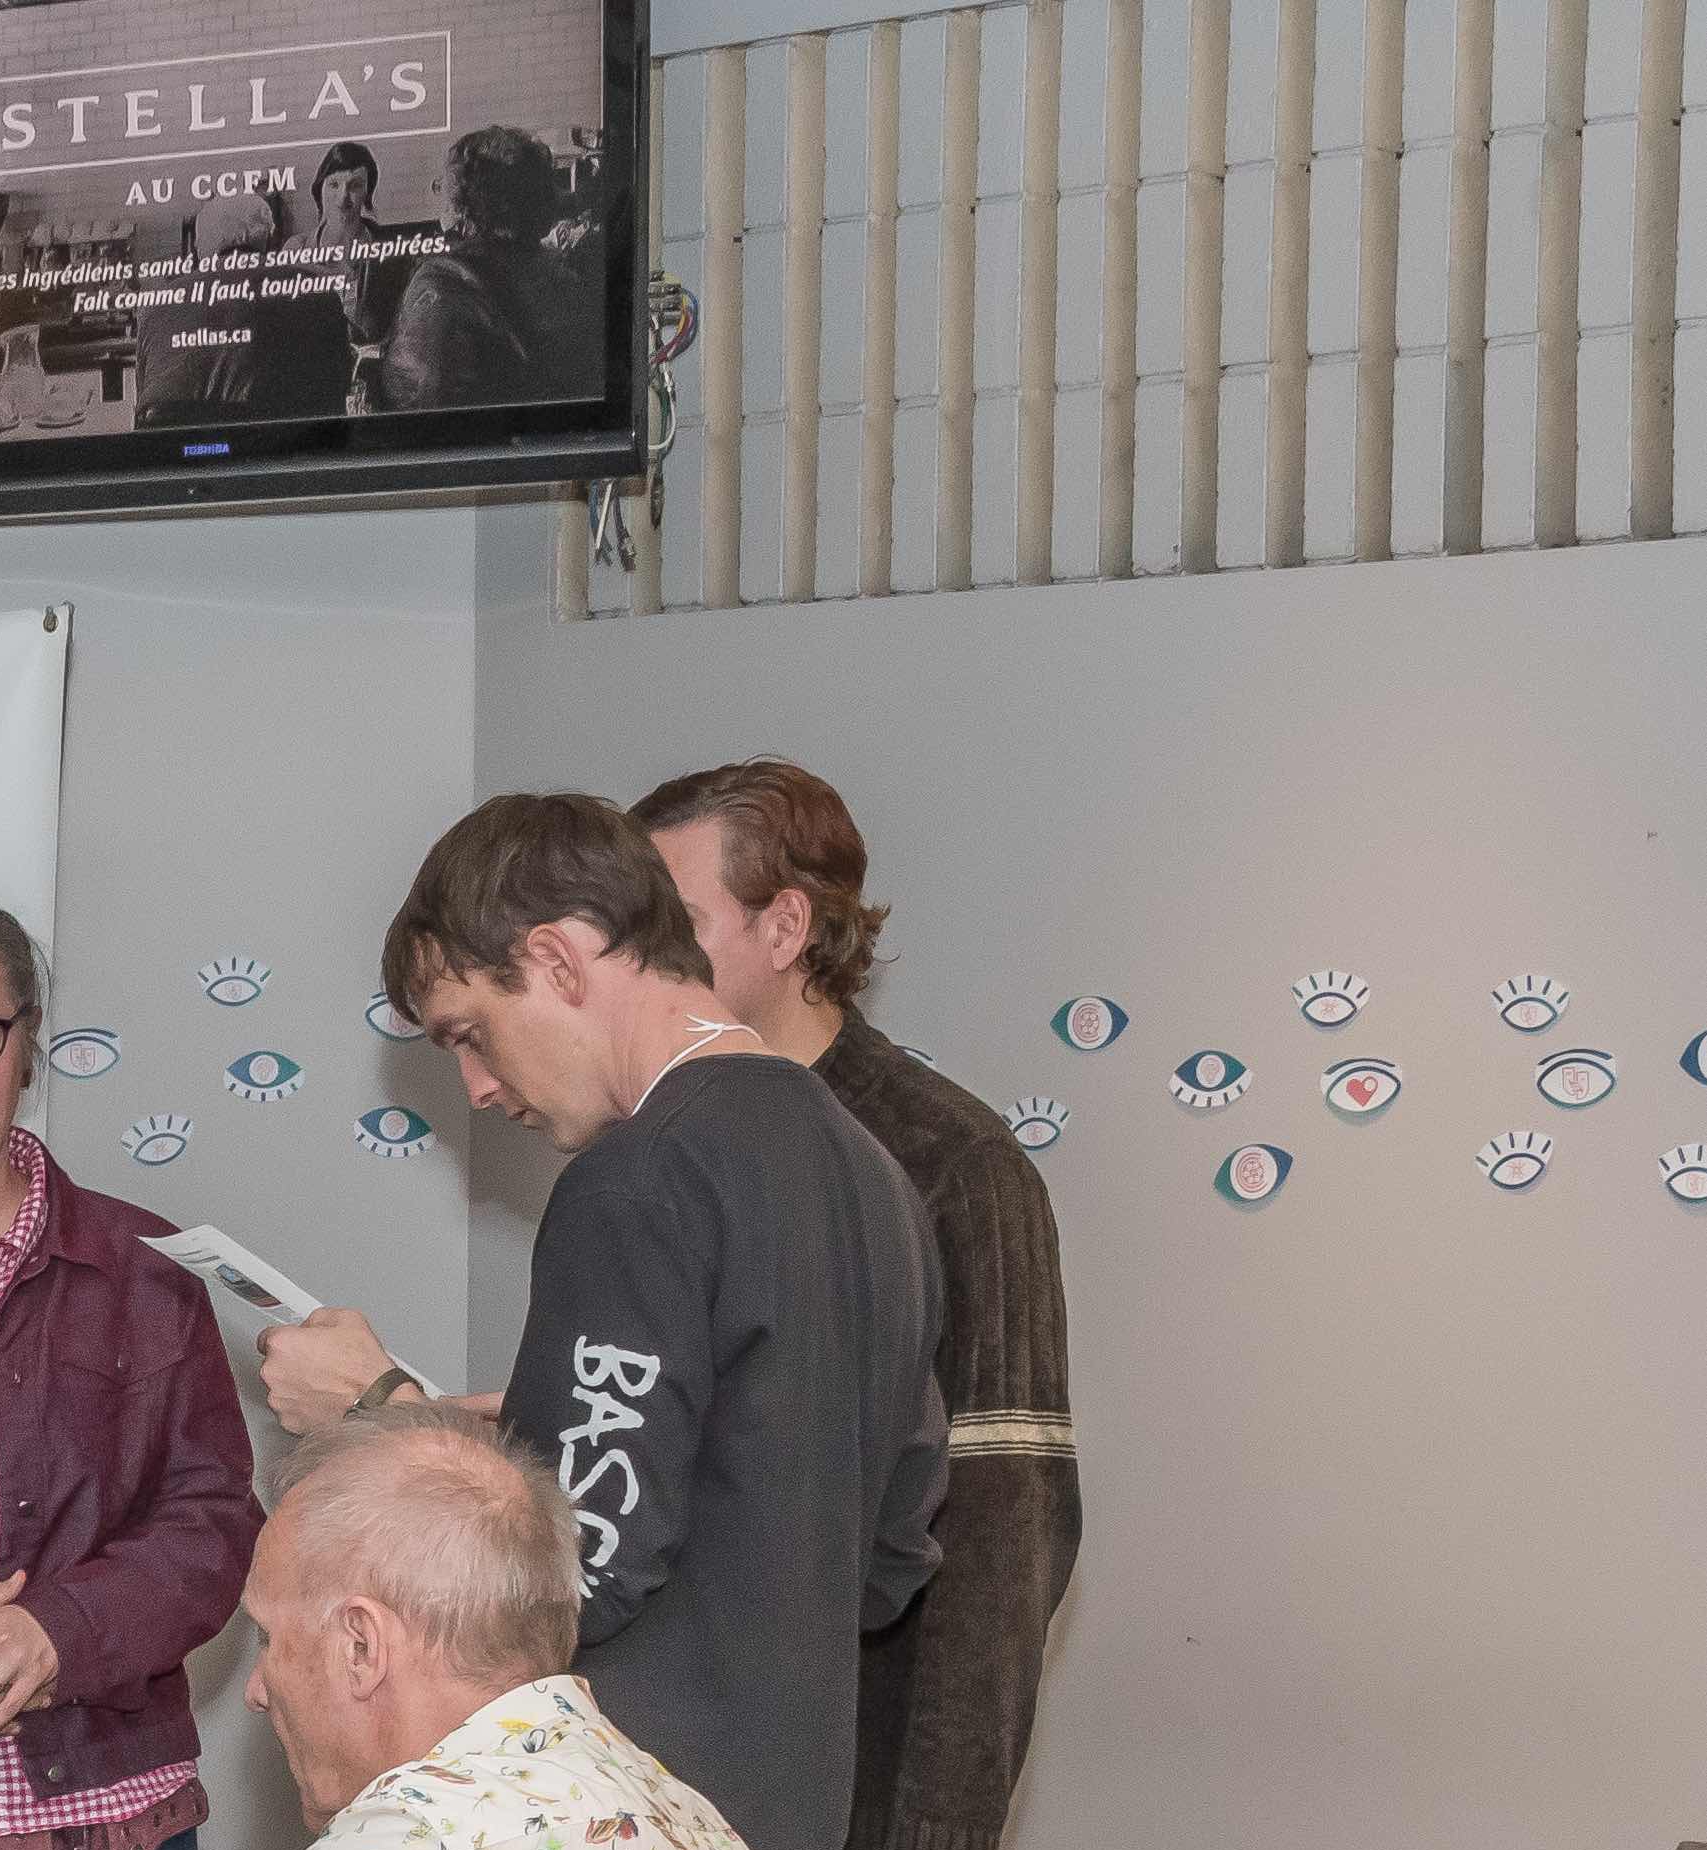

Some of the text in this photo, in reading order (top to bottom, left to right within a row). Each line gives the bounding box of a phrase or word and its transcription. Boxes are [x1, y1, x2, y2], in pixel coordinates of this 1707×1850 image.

[1, 62, 427, 151] STELLA'S
[126, 178, 173, 206] AU
[22, 260, 133, 292] ingrédients
[138, 252, 193, 278] santé
[198, 252, 219, 272] et
[224, 250, 259, 271] des
[265, 244, 344, 267] saveurs
[350, 233, 451, 264] inspirées.
[73, 273, 351, 313] Fait comme il faut, toujours.
[171, 327, 251, 348] stellas.ca
